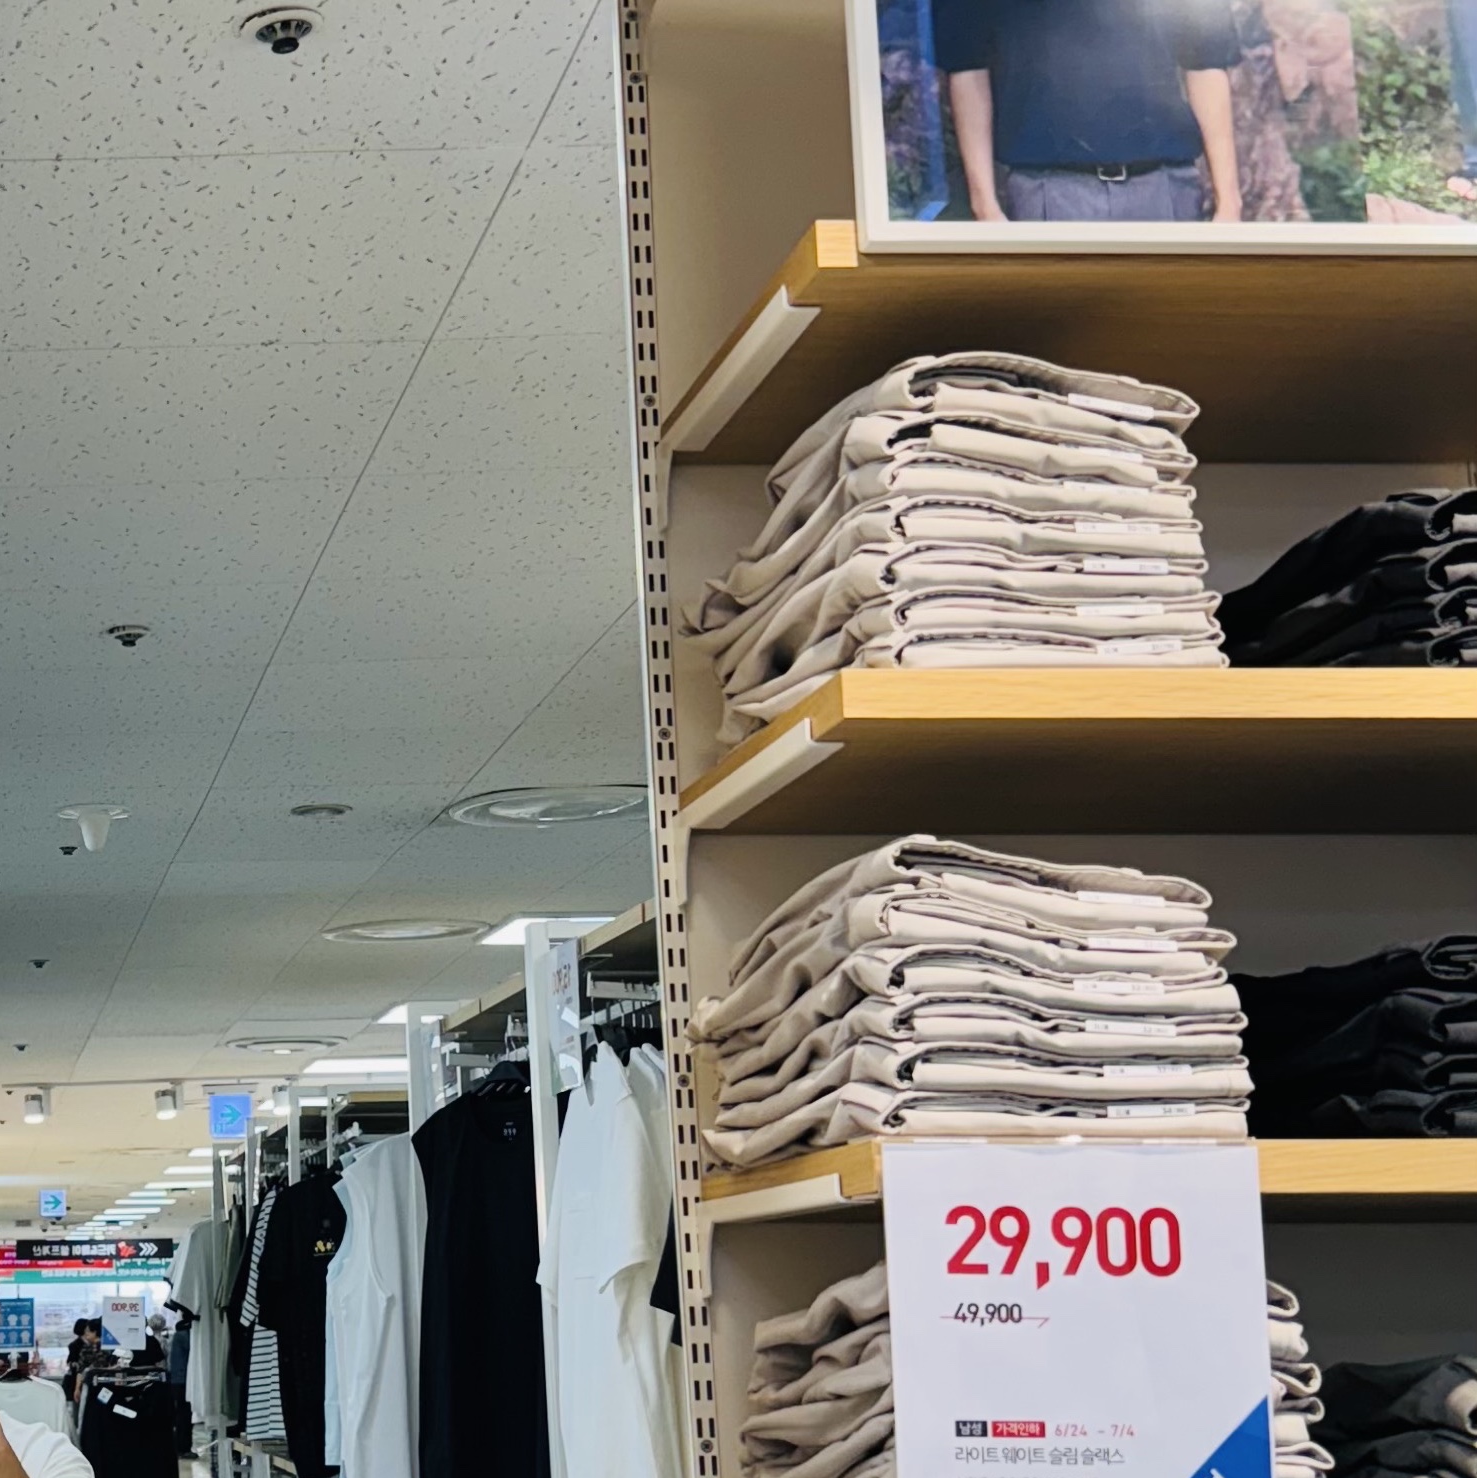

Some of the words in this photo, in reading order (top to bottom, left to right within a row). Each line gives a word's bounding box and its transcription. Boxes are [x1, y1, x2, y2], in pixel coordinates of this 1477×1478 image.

[945, 1205, 1181, 1290] 29,900
[953, 1303, 1023, 1326] 49,900
[958, 1422, 984, 1436] 남성
[995, 1422, 1041, 1437] 가격인하
[1054, 1424, 1088, 1437] 6/24
[1110, 1424, 1135, 1437] 7/4
[954, 1446, 1000, 1465] 라이트
[1002, 1446, 1047, 1465] 웨이트
[1048, 1446, 1079, 1465] 슬림
[1081, 1446, 1125, 1465] 슬랙스
